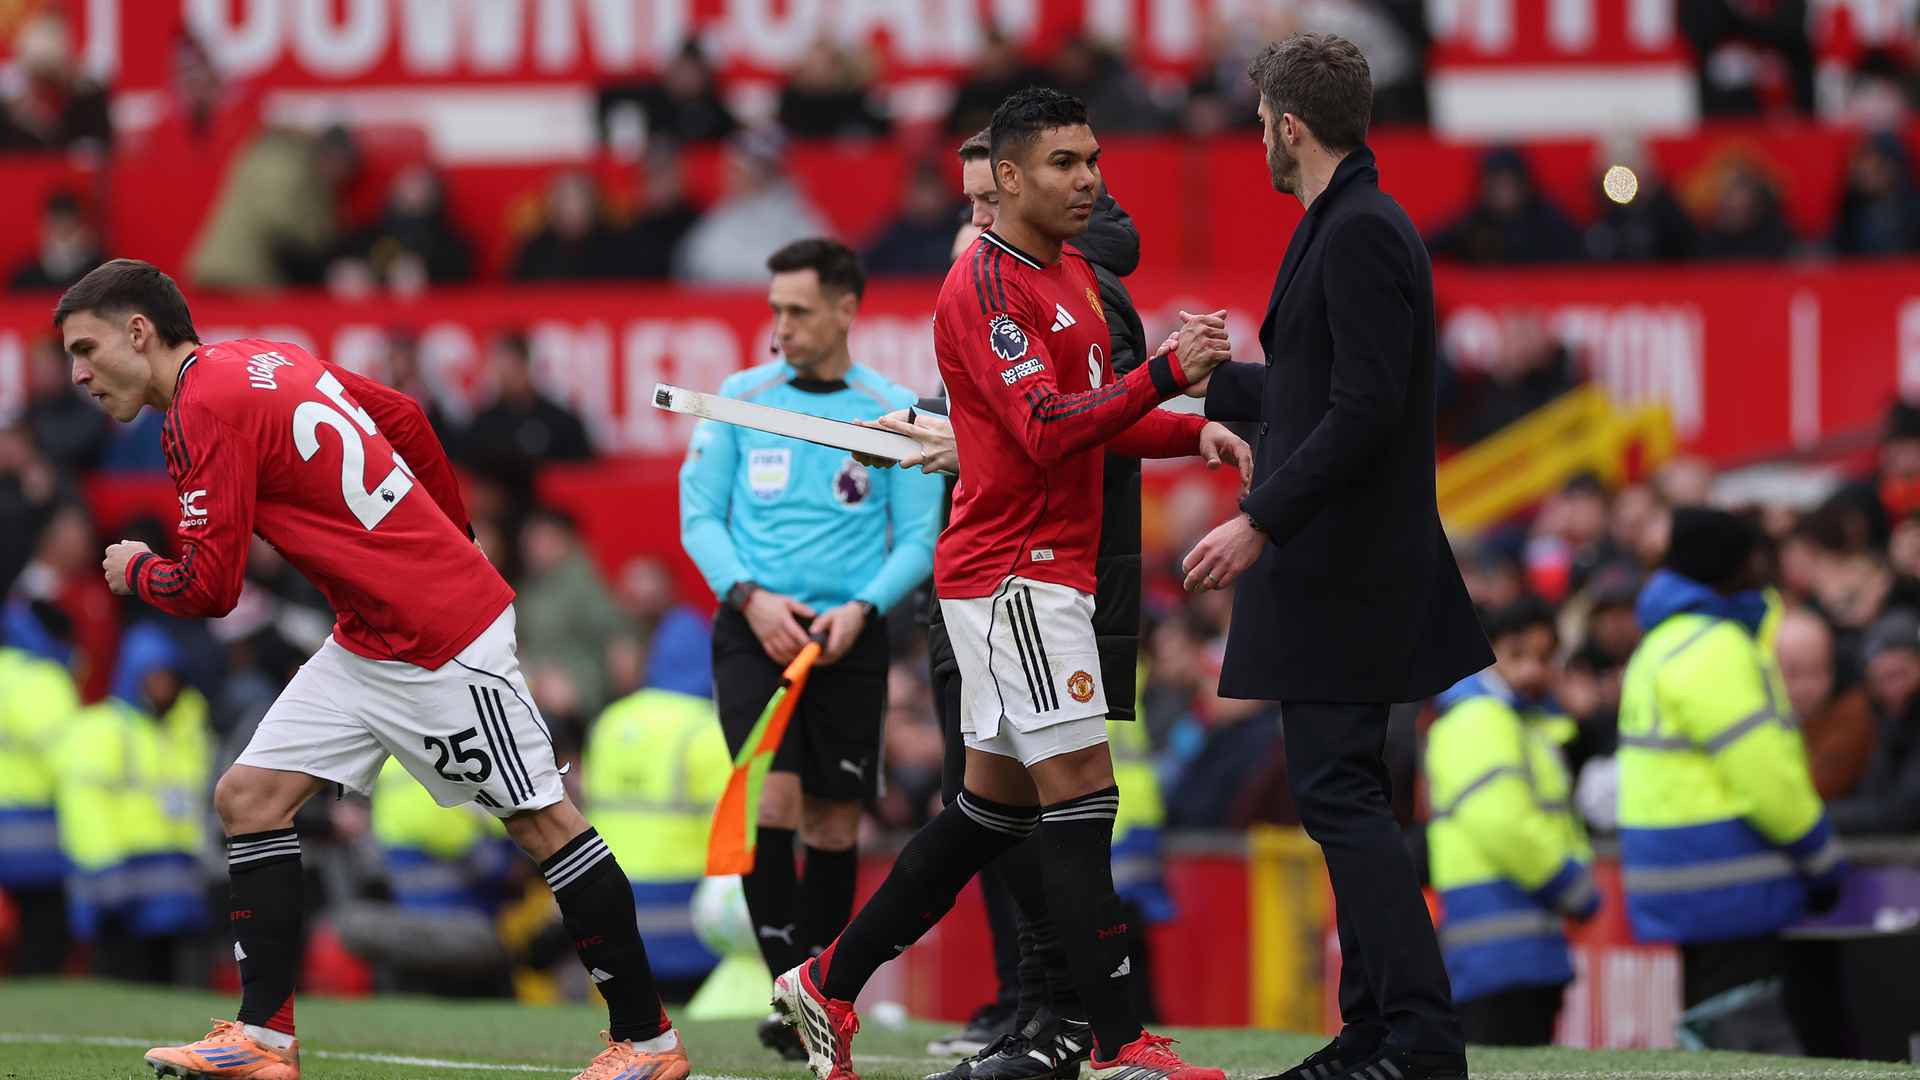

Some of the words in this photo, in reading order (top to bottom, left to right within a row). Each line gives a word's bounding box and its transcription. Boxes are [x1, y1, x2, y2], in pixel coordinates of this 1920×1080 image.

[1014, 359, 1039, 372] room
[1017, 364, 1045, 379] racism
[423, 726, 492, 783] 25
